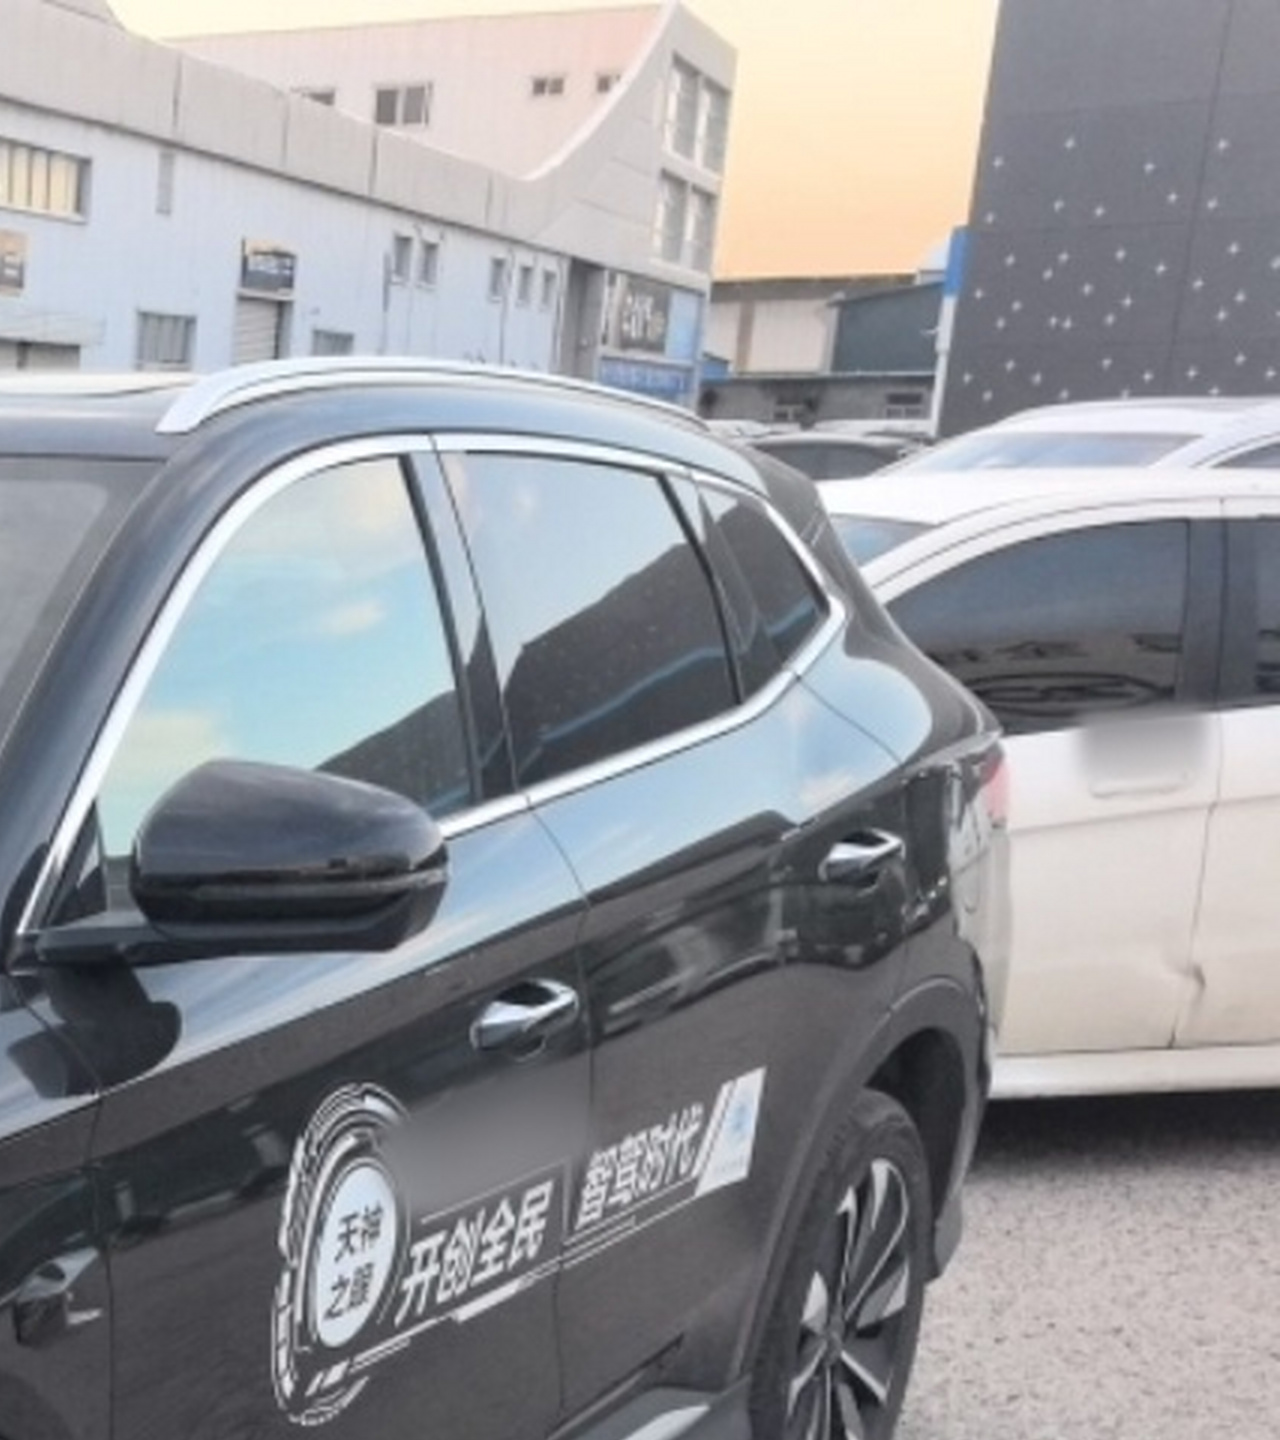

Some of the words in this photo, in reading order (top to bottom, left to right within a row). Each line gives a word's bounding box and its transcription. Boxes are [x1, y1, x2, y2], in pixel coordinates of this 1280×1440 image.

[334, 1202, 383, 1263] 天神
[394, 1179, 553, 1327] 开创全民
[574, 1103, 704, 1231] 智驾时代
